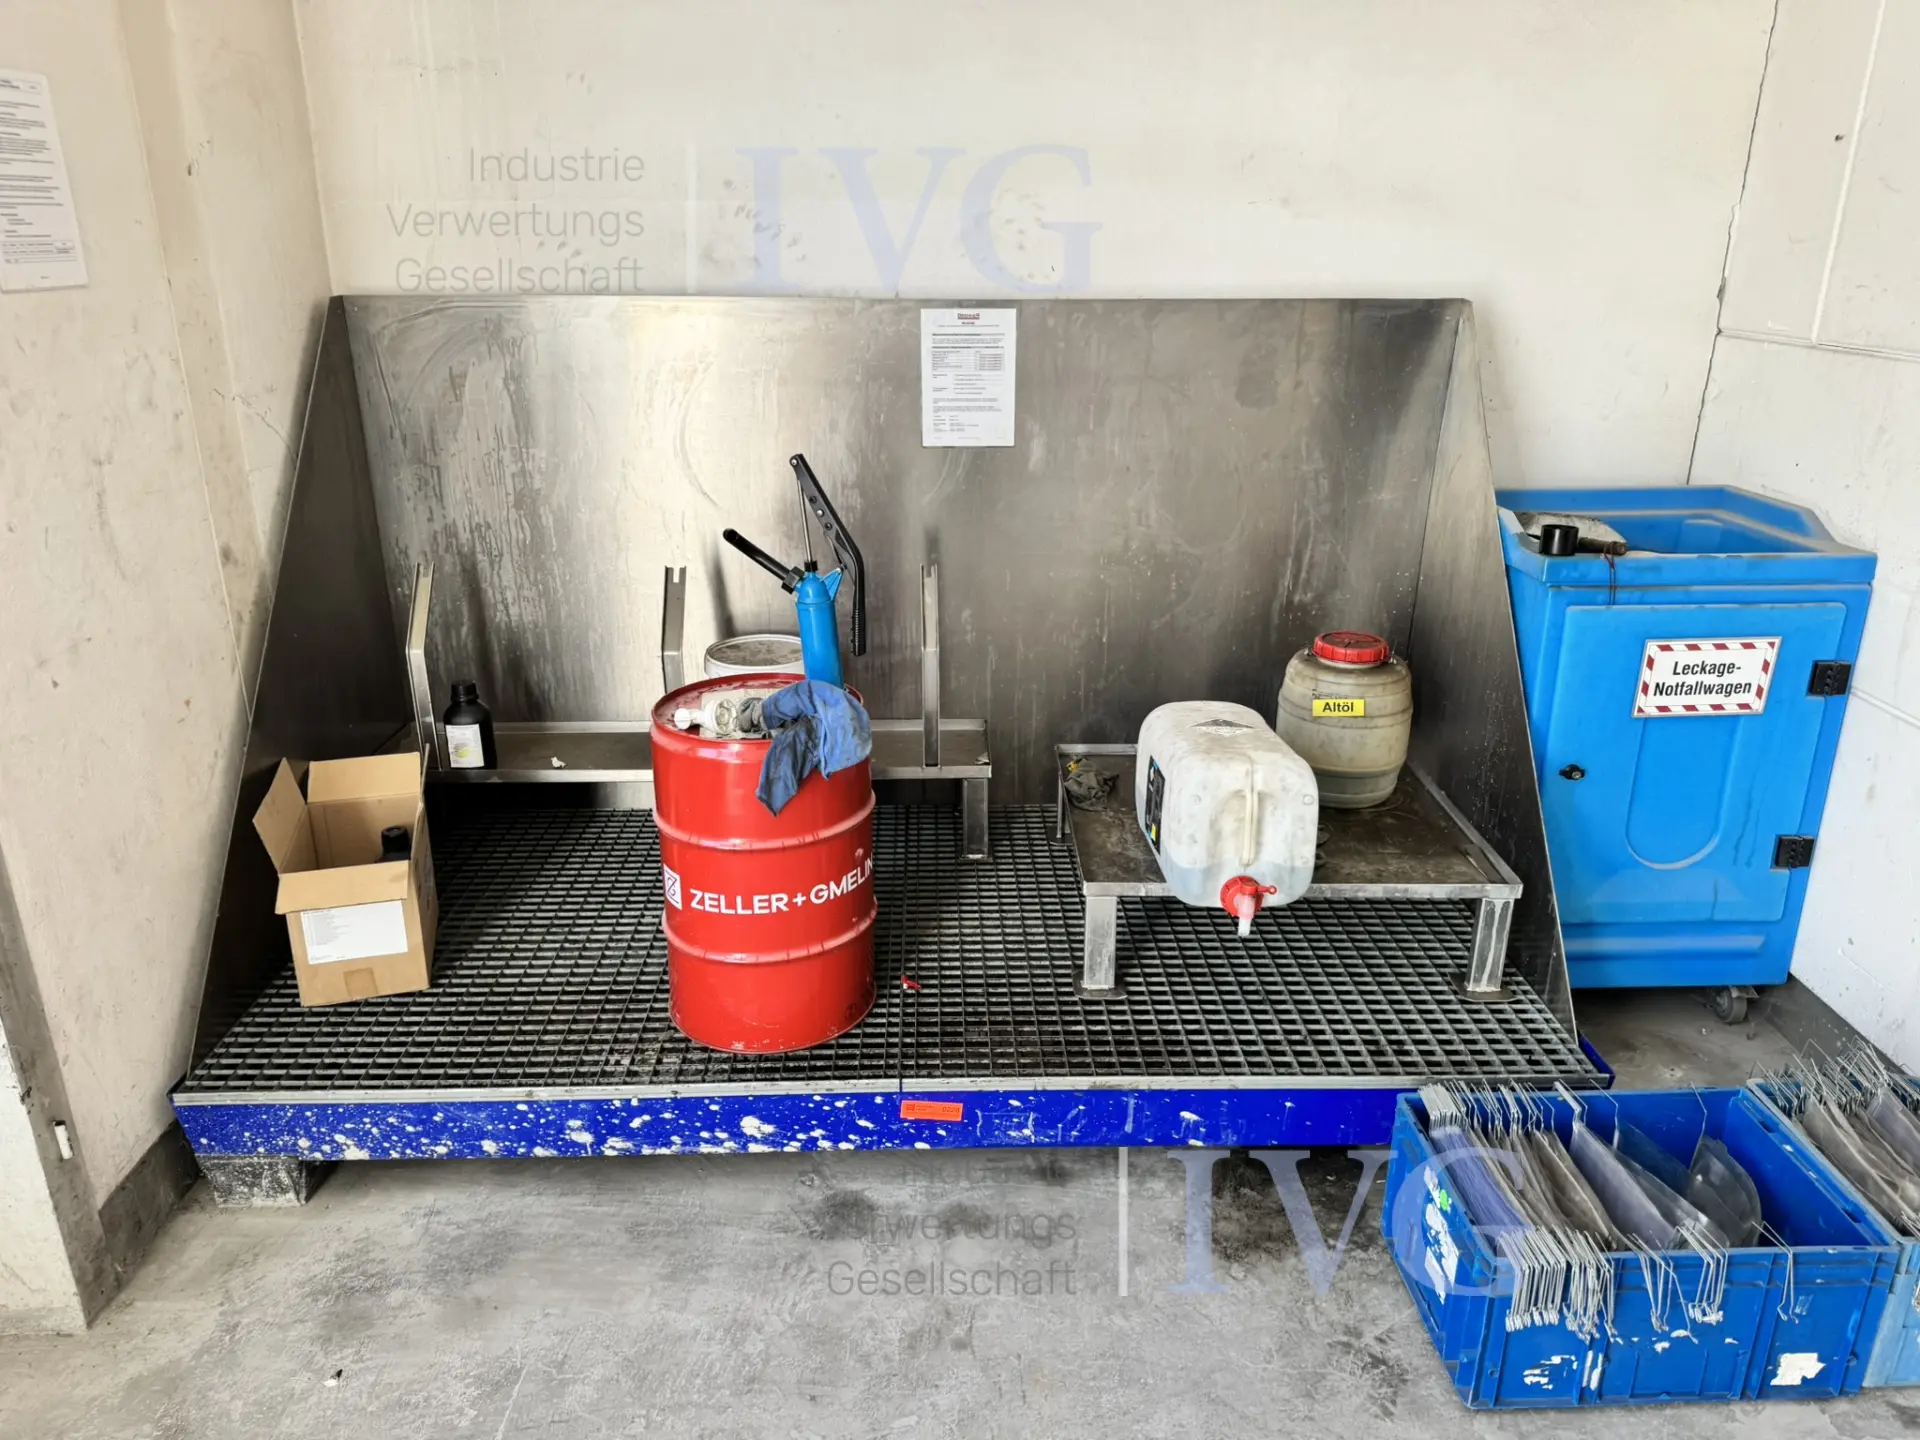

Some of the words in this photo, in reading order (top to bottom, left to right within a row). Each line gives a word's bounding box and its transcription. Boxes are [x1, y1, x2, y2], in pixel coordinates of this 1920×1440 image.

[1672, 660, 1742, 677] Leckage-
[1653, 681, 1752, 698] Notfallwagen
[1322, 702, 1354, 713] Altöl
[689, 889, 790, 915] ZELLER
[793, 893, 807, 907] +
